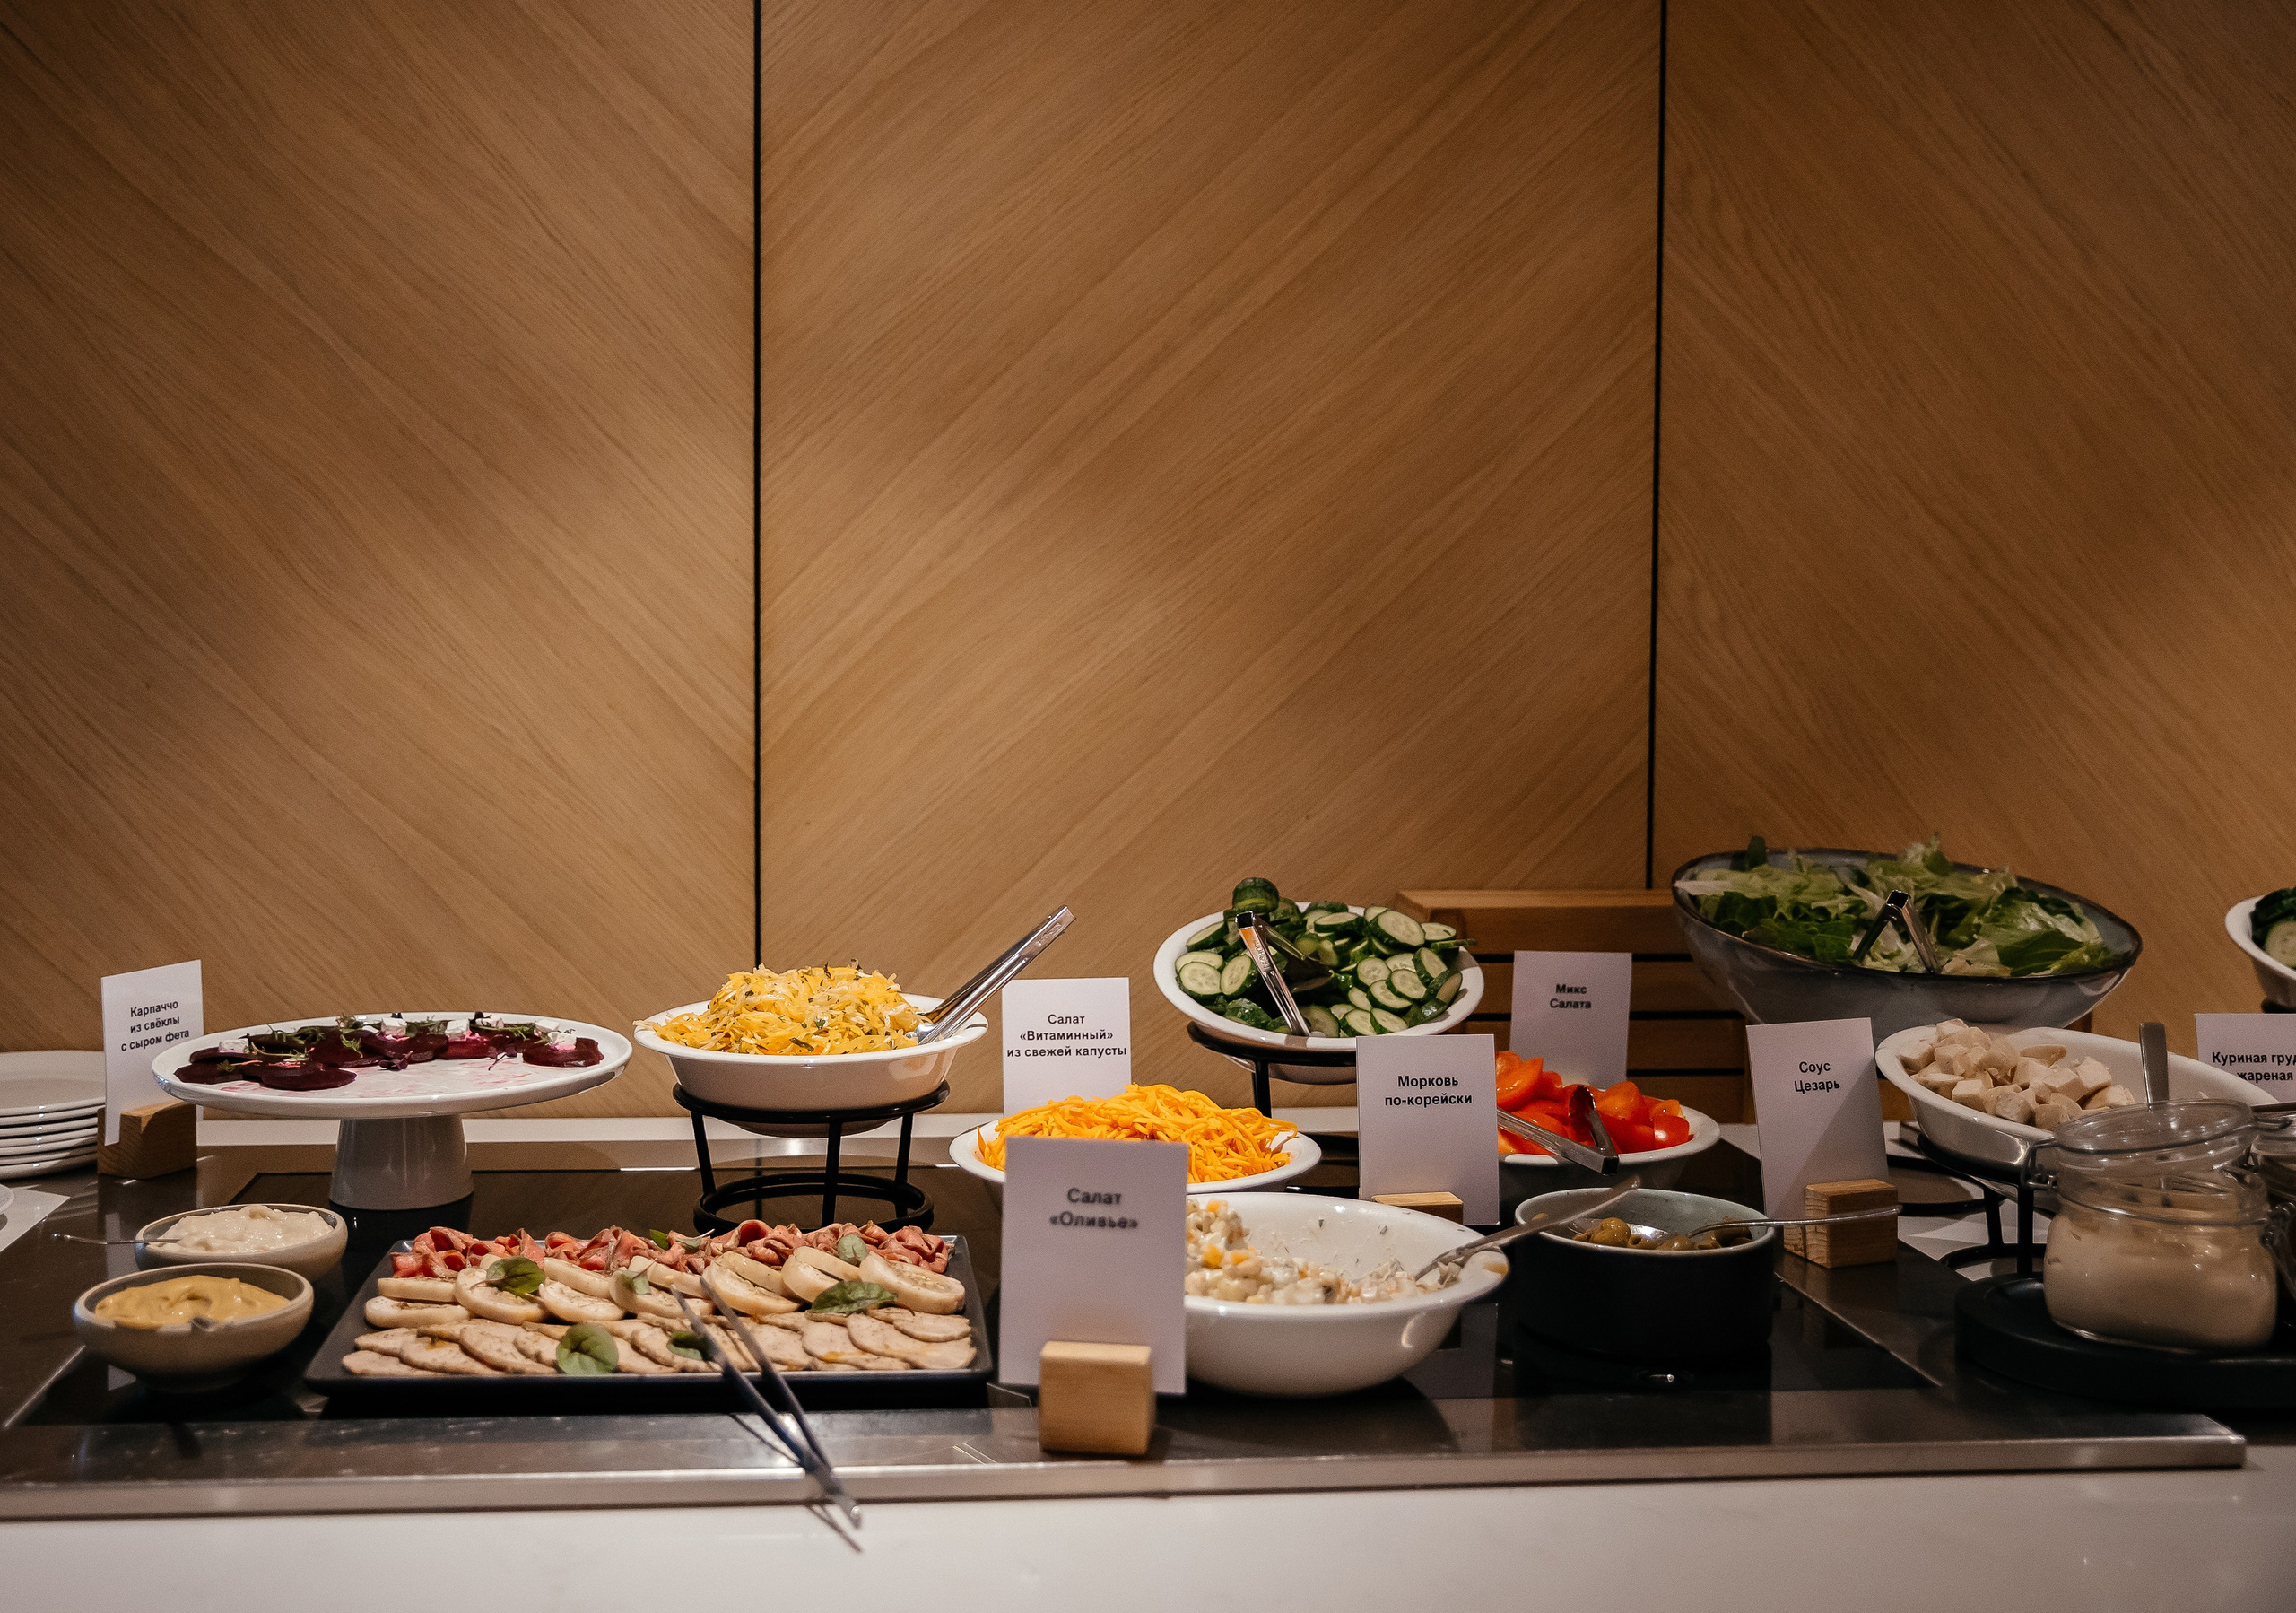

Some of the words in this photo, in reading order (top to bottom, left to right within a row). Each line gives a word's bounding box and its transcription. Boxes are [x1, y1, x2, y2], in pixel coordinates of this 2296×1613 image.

[1555, 983, 1587, 994] Микс
[129, 1001, 179, 1017] Карпаччо
[1549, 998, 1592, 1009] Салата
[129, 1024, 142, 1033] из
[144, 1016, 180, 1031] свёклы
[1048, 1014, 1085, 1024] Салат
[120, 1042, 127, 1052] с
[129, 1035, 162, 1050] сыром
[165, 1029, 190, 1043] фета
[1020, 1029, 1114, 1041] «Витаминный»
[1006, 1049, 1021, 1058] из
[1024, 1045, 1072, 1058] свежей
[1075, 1046, 1127, 1059] капусты
[2212, 1051, 2268, 1066] Куриная
[1798, 1061, 1831, 1075] Соус
[1397, 1075, 1459, 1089] Морковь
[1794, 1079, 1840, 1094] Цезарь
[1385, 1092, 1472, 1108] по-корейски
[1066, 1187, 1122, 1204] Салат
[1049, 1211, 1139, 1228] «Оливье»
